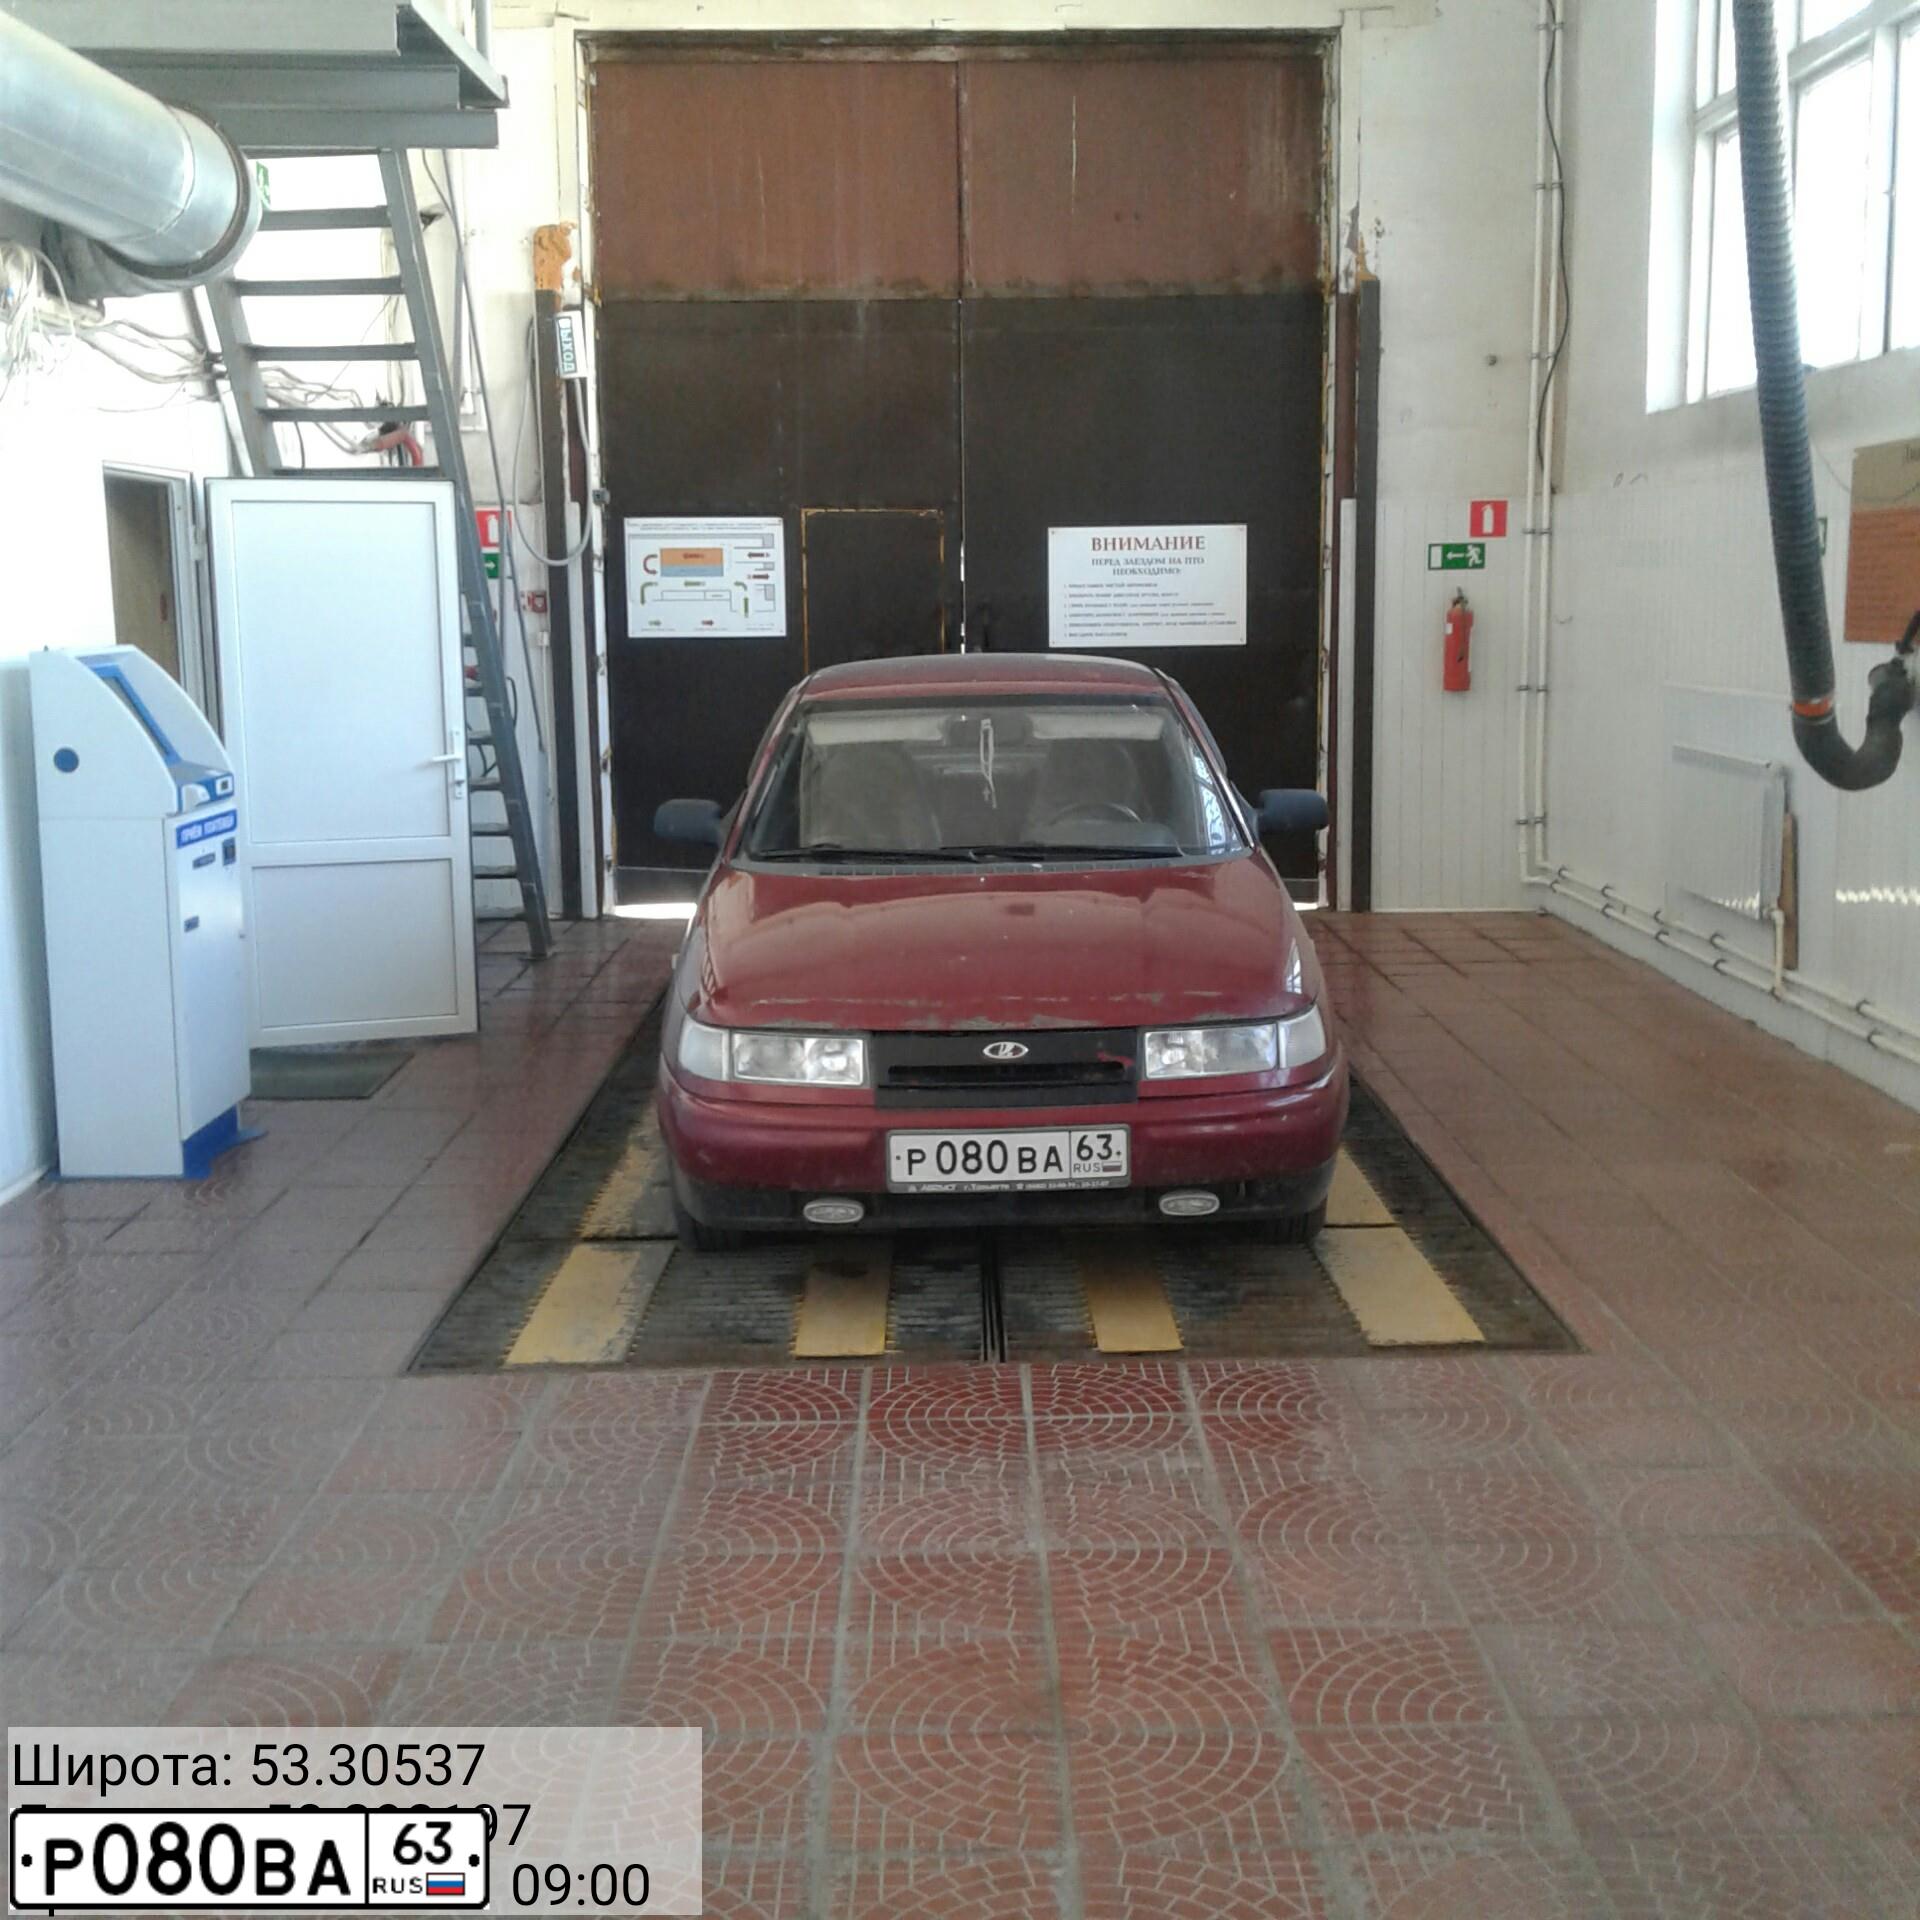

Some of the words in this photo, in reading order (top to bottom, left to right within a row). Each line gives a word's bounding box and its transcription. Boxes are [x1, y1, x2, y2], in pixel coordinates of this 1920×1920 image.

[1091, 536, 1206, 552] ВНИМАНИЕ
[1091, 557, 1121, 567] ПЕРЕД
[1168, 556, 1183, 566] НА
[1076, 1133, 1113, 1161] 63
[1073, 1163, 1101, 1173] RUS
